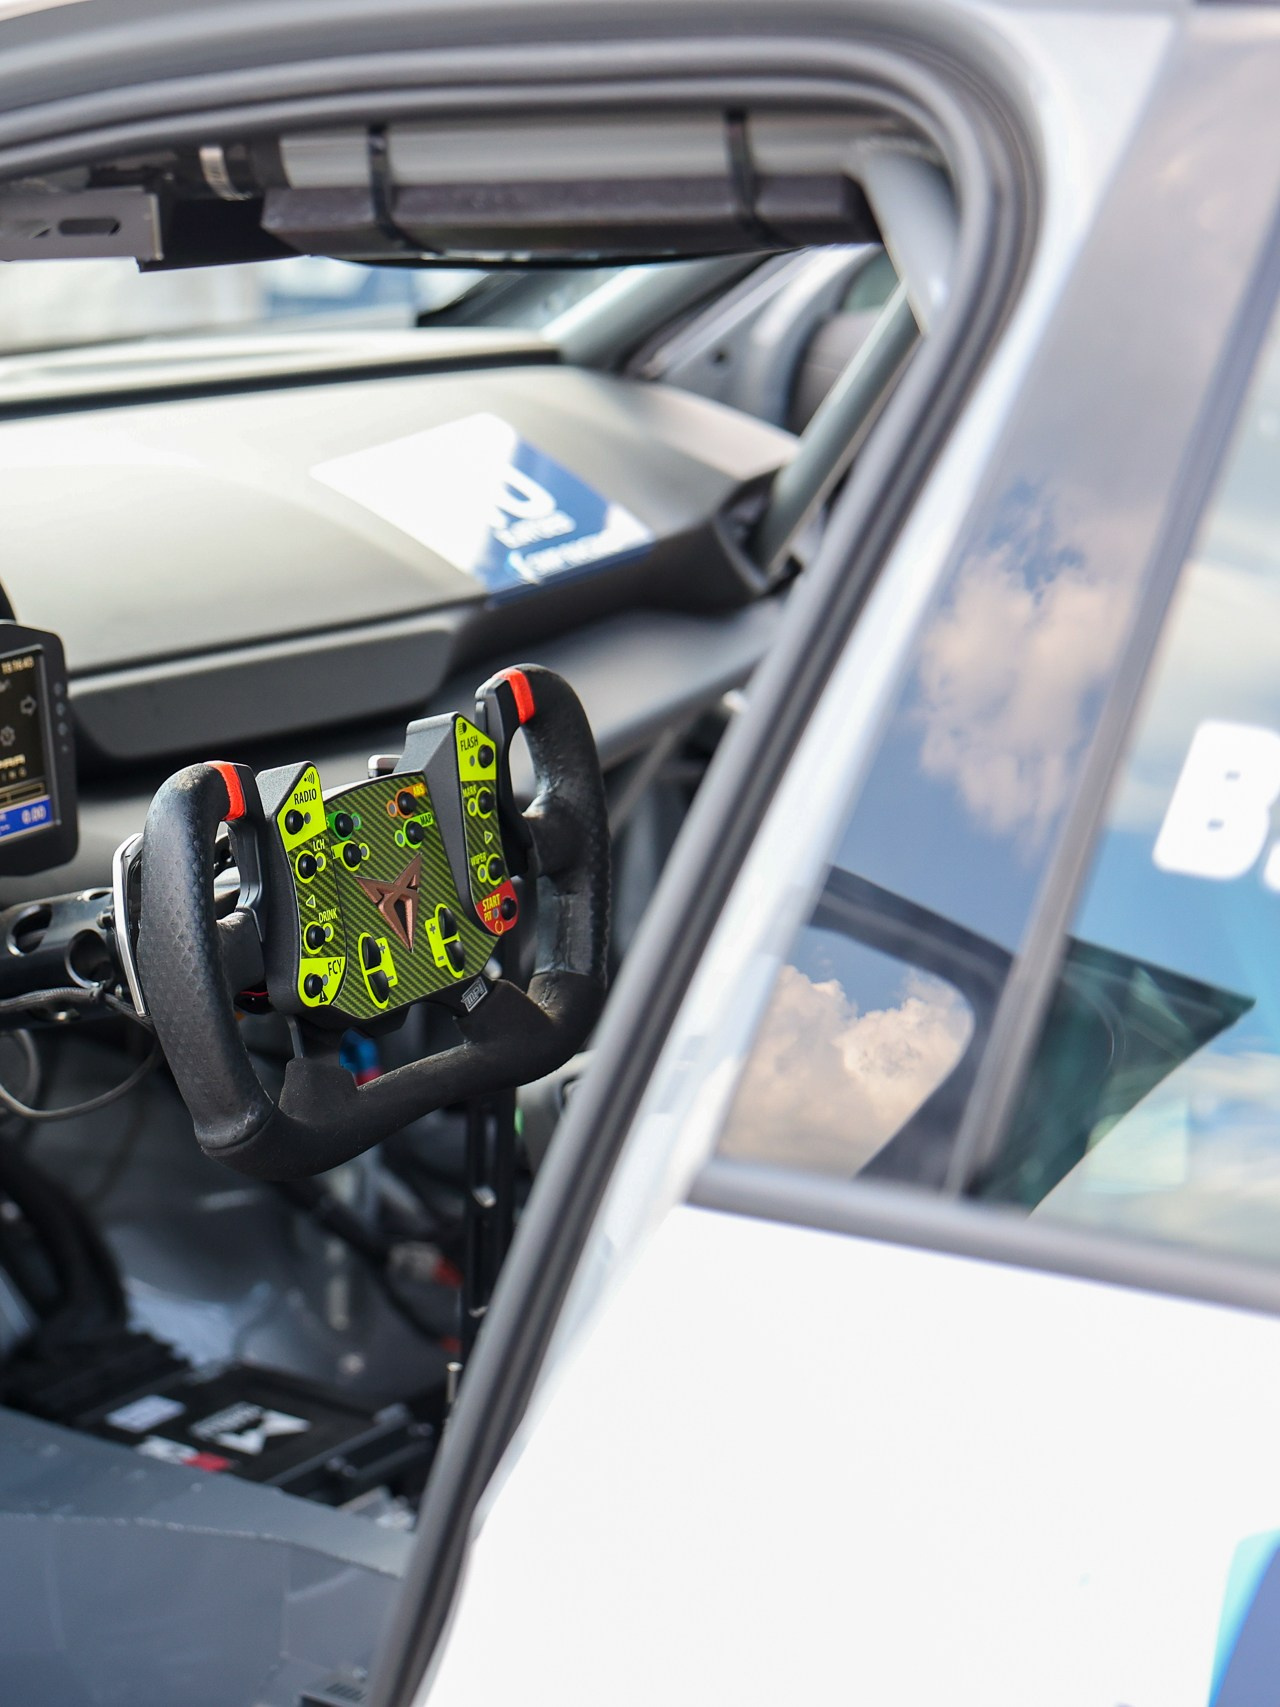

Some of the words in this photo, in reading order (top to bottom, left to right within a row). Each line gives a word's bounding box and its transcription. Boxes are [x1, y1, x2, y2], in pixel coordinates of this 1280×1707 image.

[460, 736, 479, 751] FLASH
[294, 788, 317, 805] RADIO
[420, 813, 432, 826] MAP
[313, 839, 325, 852] LCH
[471, 852, 487, 866] WIPER
[482, 893, 501, 912] START
[318, 908, 338, 923] DRINK
[328, 959, 342, 977] FCY
